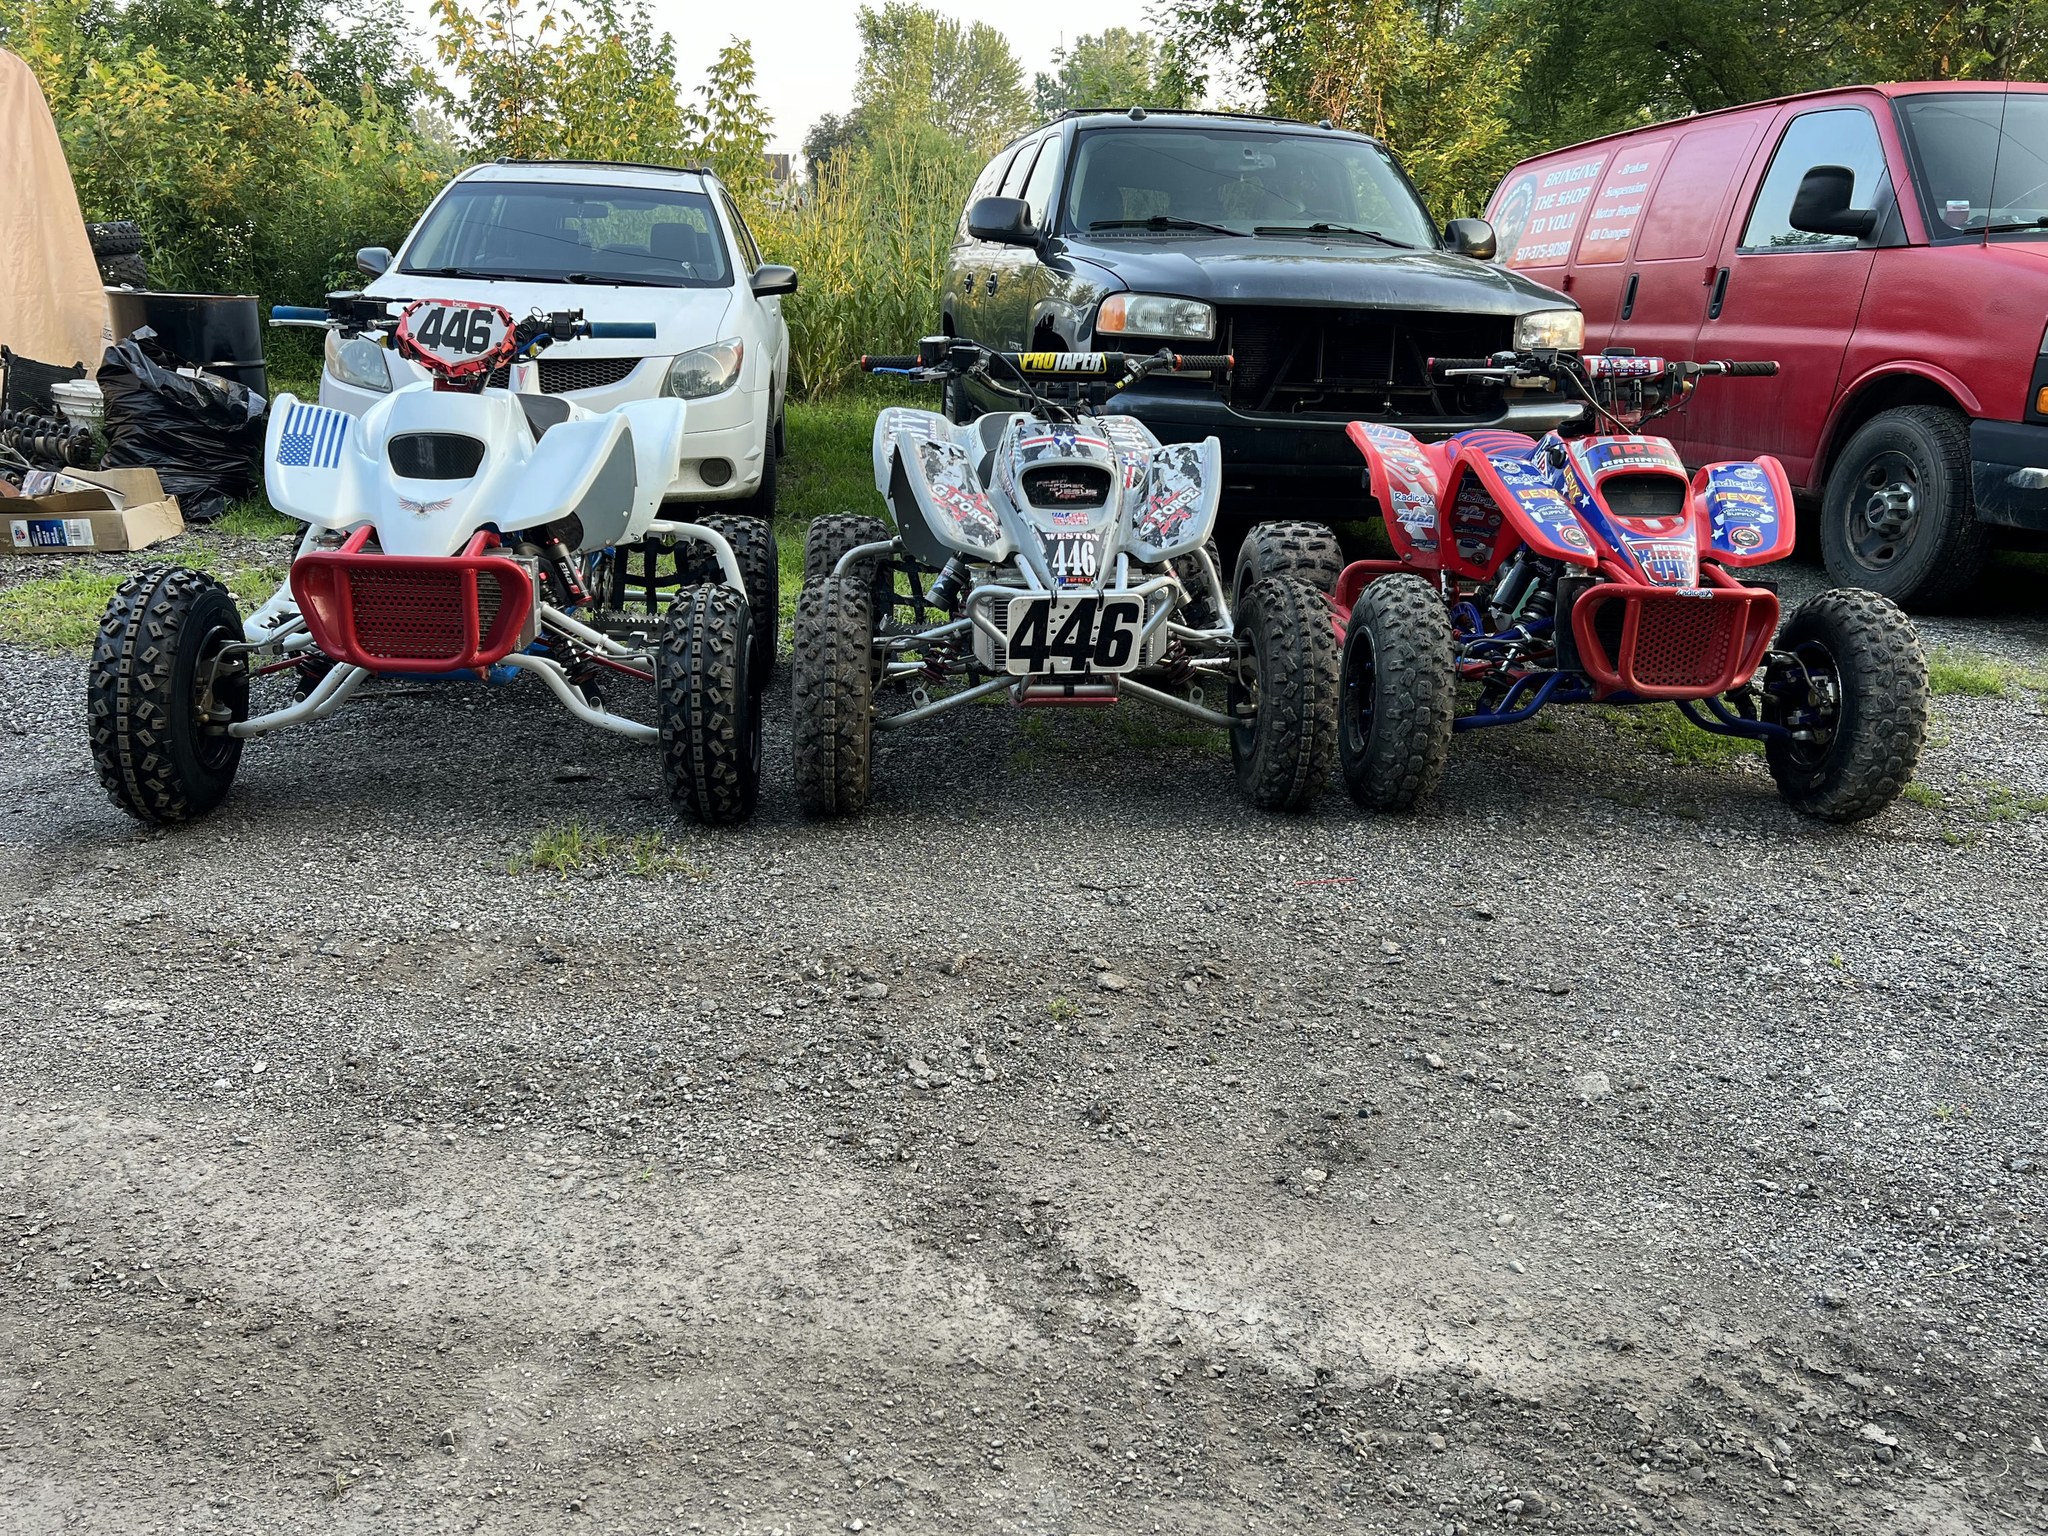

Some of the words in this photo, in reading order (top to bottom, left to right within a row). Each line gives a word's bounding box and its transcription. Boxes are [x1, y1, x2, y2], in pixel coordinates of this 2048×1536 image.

[1543, 162, 1602, 187] BRINGING
[1534, 194, 1558, 211] THE
[1556, 186, 1591, 206] SHOP
[1530, 217, 1546, 234] TO
[417, 307, 493, 354] 446
[1564, 464, 1582, 498] LEVY
[1150, 487, 1200, 521] FORCE
[1715, 492, 1766, 504] LEVY
[1045, 533, 1100, 541] WESTON
[1052, 540, 1096, 576] 446
[1008, 598, 1140, 672] 446
